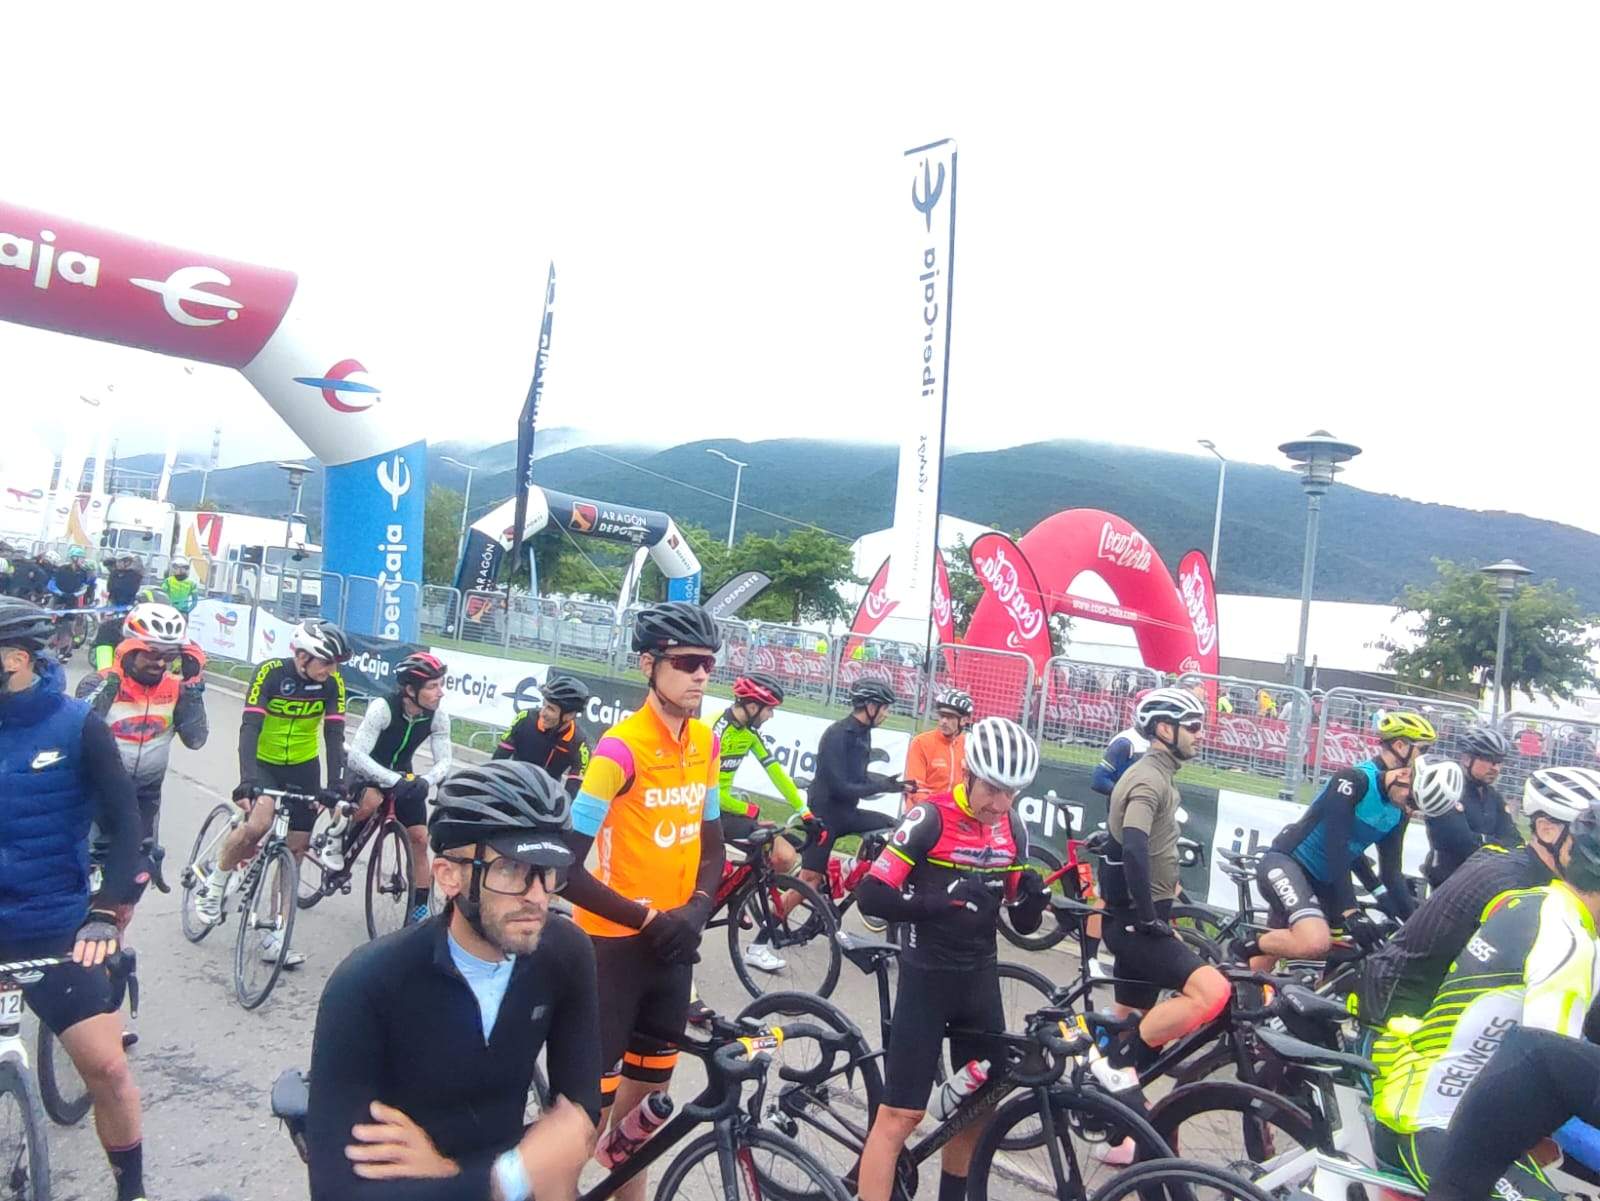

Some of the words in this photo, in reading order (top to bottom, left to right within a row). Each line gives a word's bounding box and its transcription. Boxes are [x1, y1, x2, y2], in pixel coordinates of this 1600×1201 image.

[247, 658, 284, 705] DONOSTIA
[266, 698, 325, 716] EGIA
[1436, 1015, 1517, 1099] EDELWEISS
